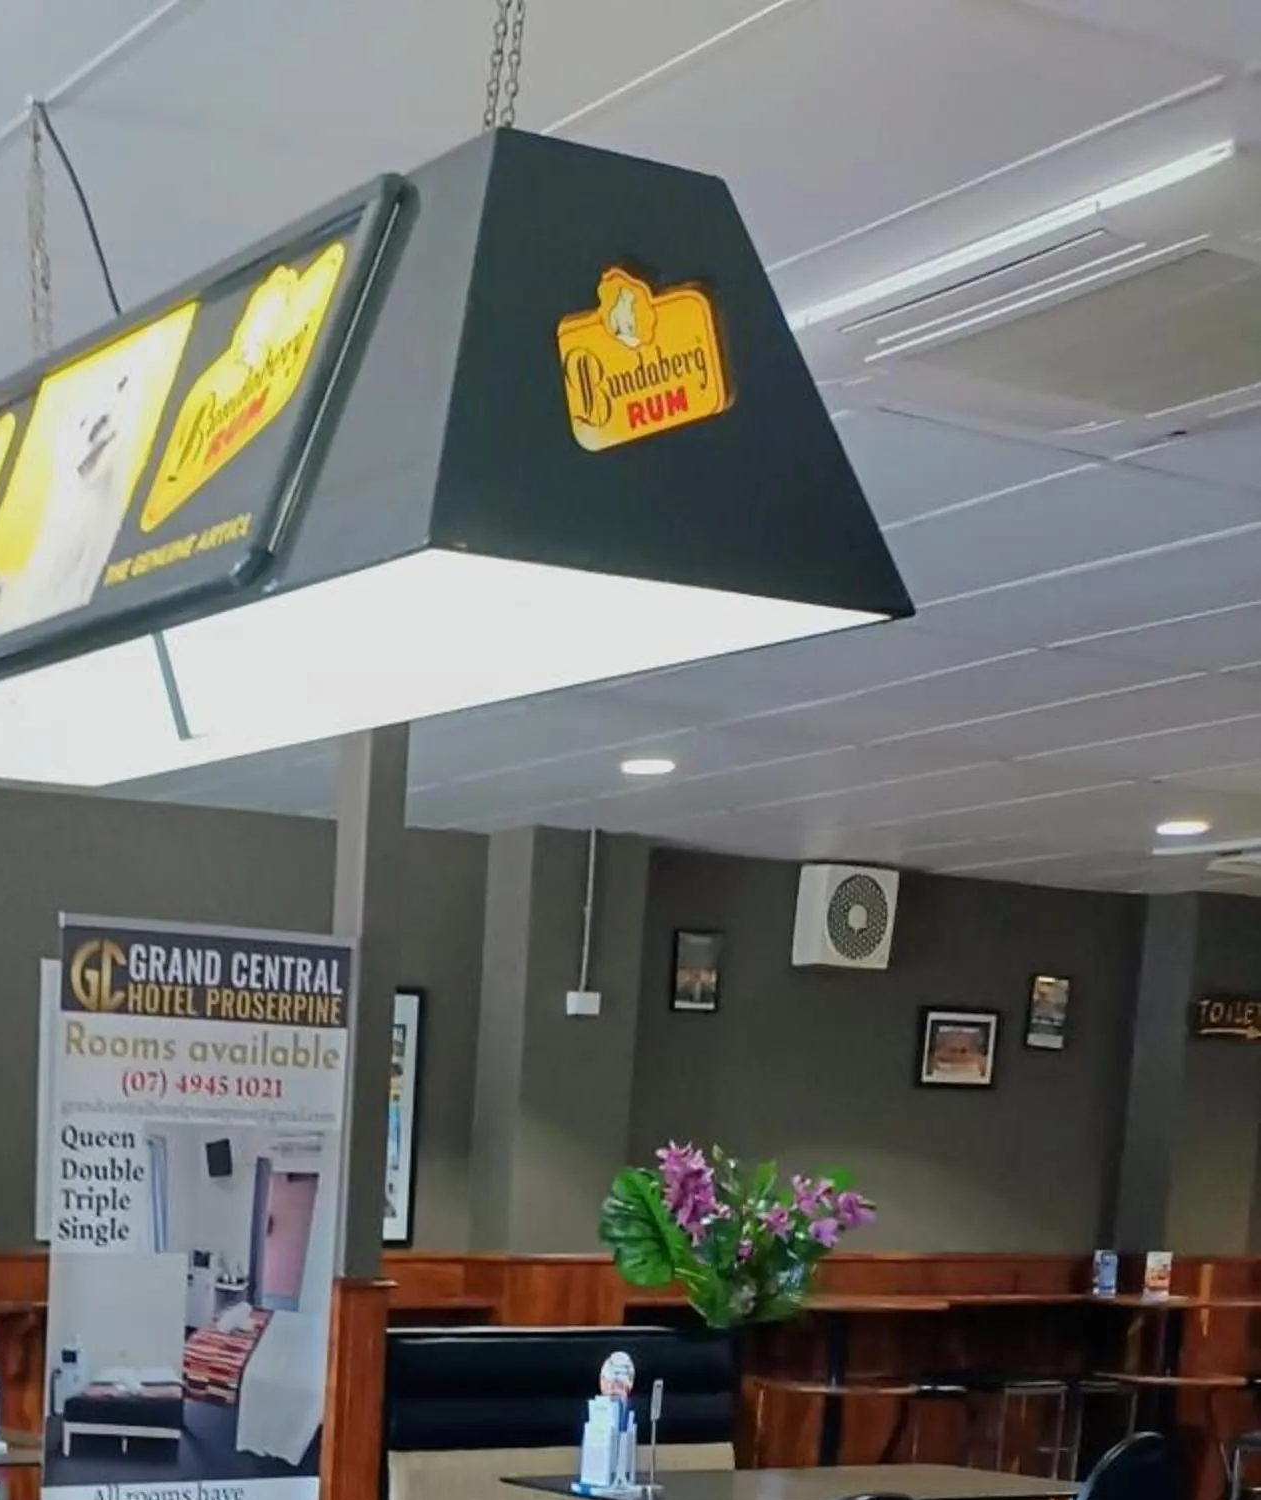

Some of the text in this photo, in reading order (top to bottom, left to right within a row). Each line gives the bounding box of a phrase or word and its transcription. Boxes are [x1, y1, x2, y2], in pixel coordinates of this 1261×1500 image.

[564, 336, 709, 428] Bundaberg
[627, 386, 688, 430] RUM
[71, 939, 127, 1011] GC
[129, 944, 342, 994] GRAND CENTRAL
[128, 984, 341, 1025] HOTEL PROSERPINE
[1199, 1000, 1261, 1025] TOILE
[66, 1021, 339, 1069] Rooms available
[122, 1070, 283, 1099] (07) 4945 1021
[62, 1125, 135, 1150] Queen
[62, 1158, 145, 1182] Double
[62, 1189, 131, 1217] Triple
[58, 1220, 130, 1247] Single
